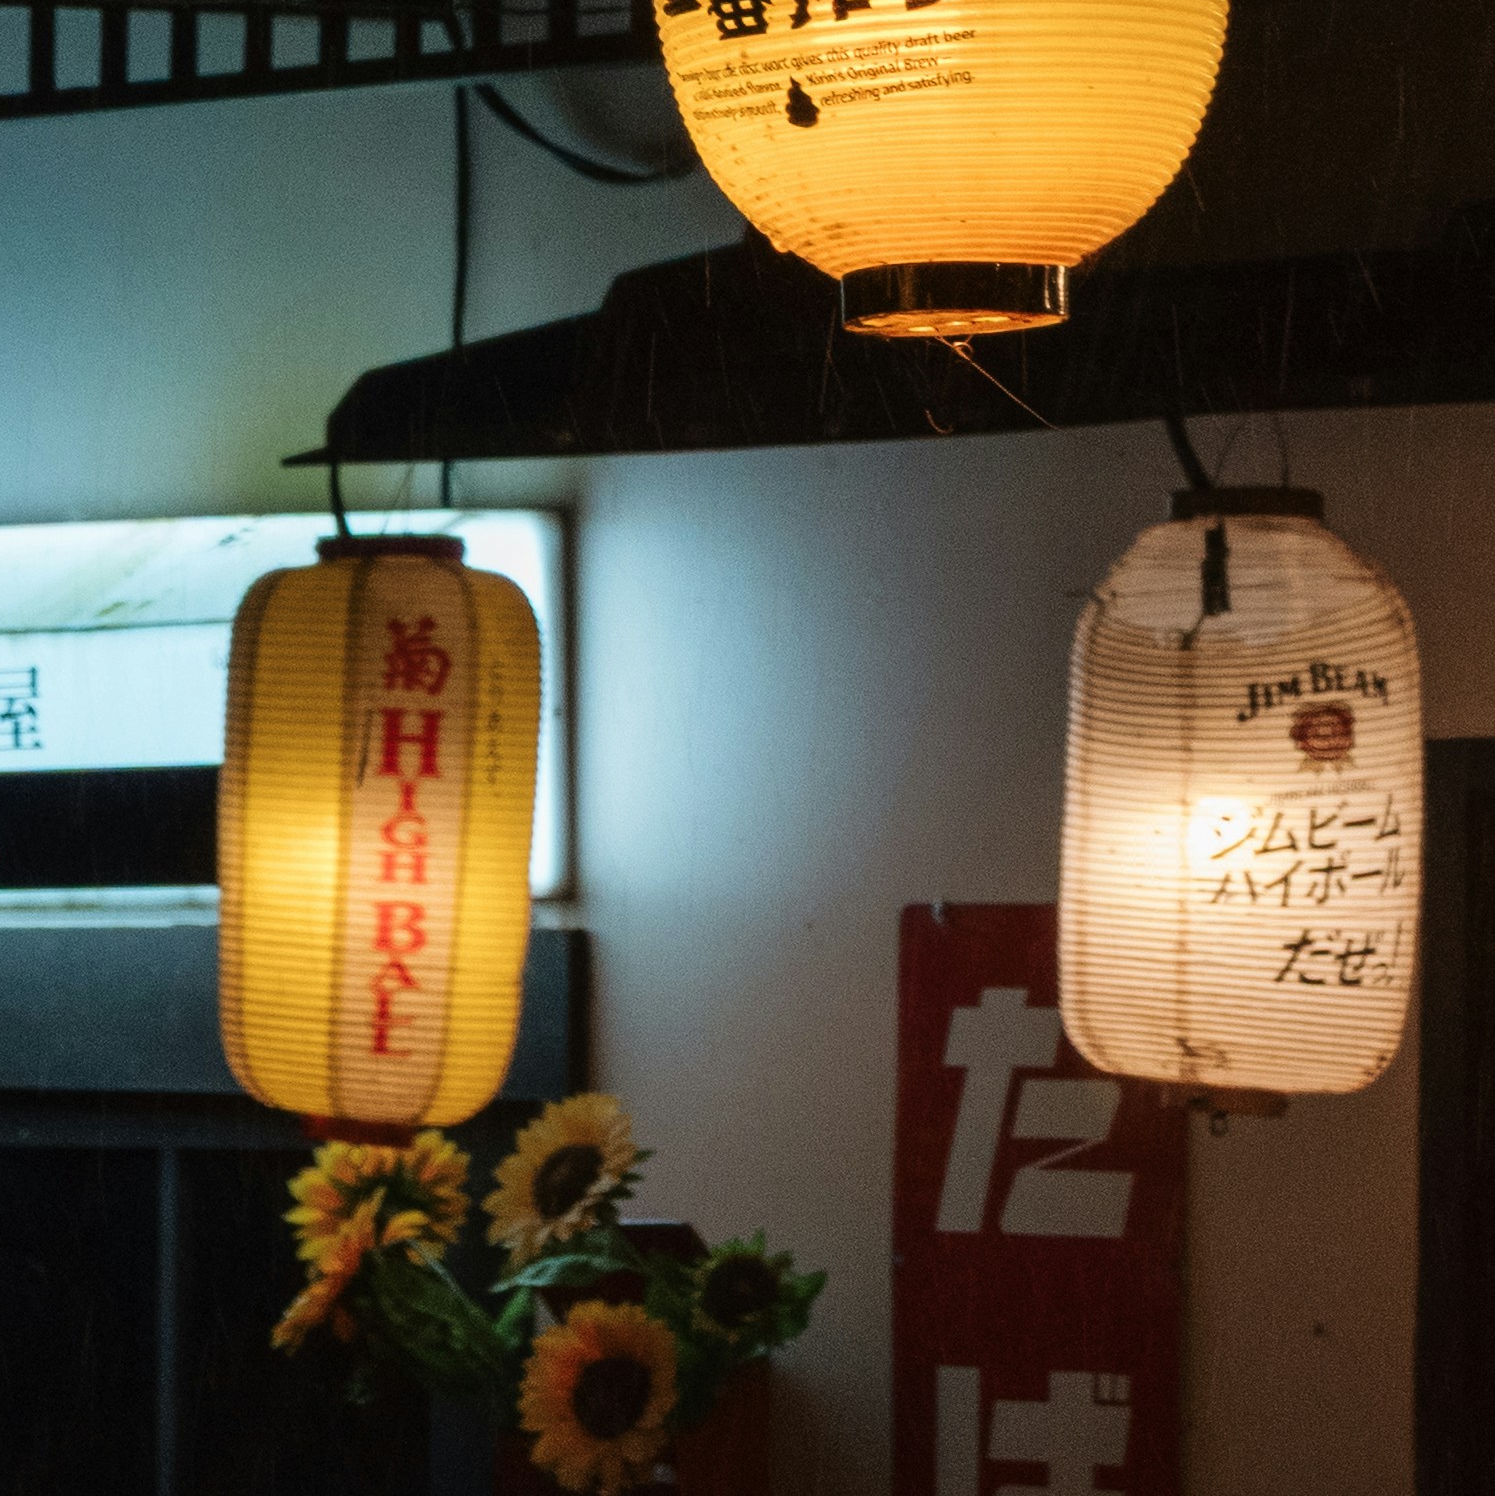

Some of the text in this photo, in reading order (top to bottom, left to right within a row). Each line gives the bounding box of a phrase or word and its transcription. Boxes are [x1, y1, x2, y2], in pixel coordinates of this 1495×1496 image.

[791, 55, 823, 72] gives
[826, 46, 850, 64] this
[854, 40, 901, 61] quality
[904, 33, 940, 49] draft
[943, 29, 976, 43] beer
[806, 70, 846, 87] Kirin's
[847, 58, 902, 80] Original
[904, 56, 940, 71] Brew
[820, 70, 976, 107] refreshing and satisfying.
[1235, 662, 1389, 722] JIM BEAM
[1210, 792, 1402, 860] ジムビーム
[1210, 846, 1404, 907] ハイボール
